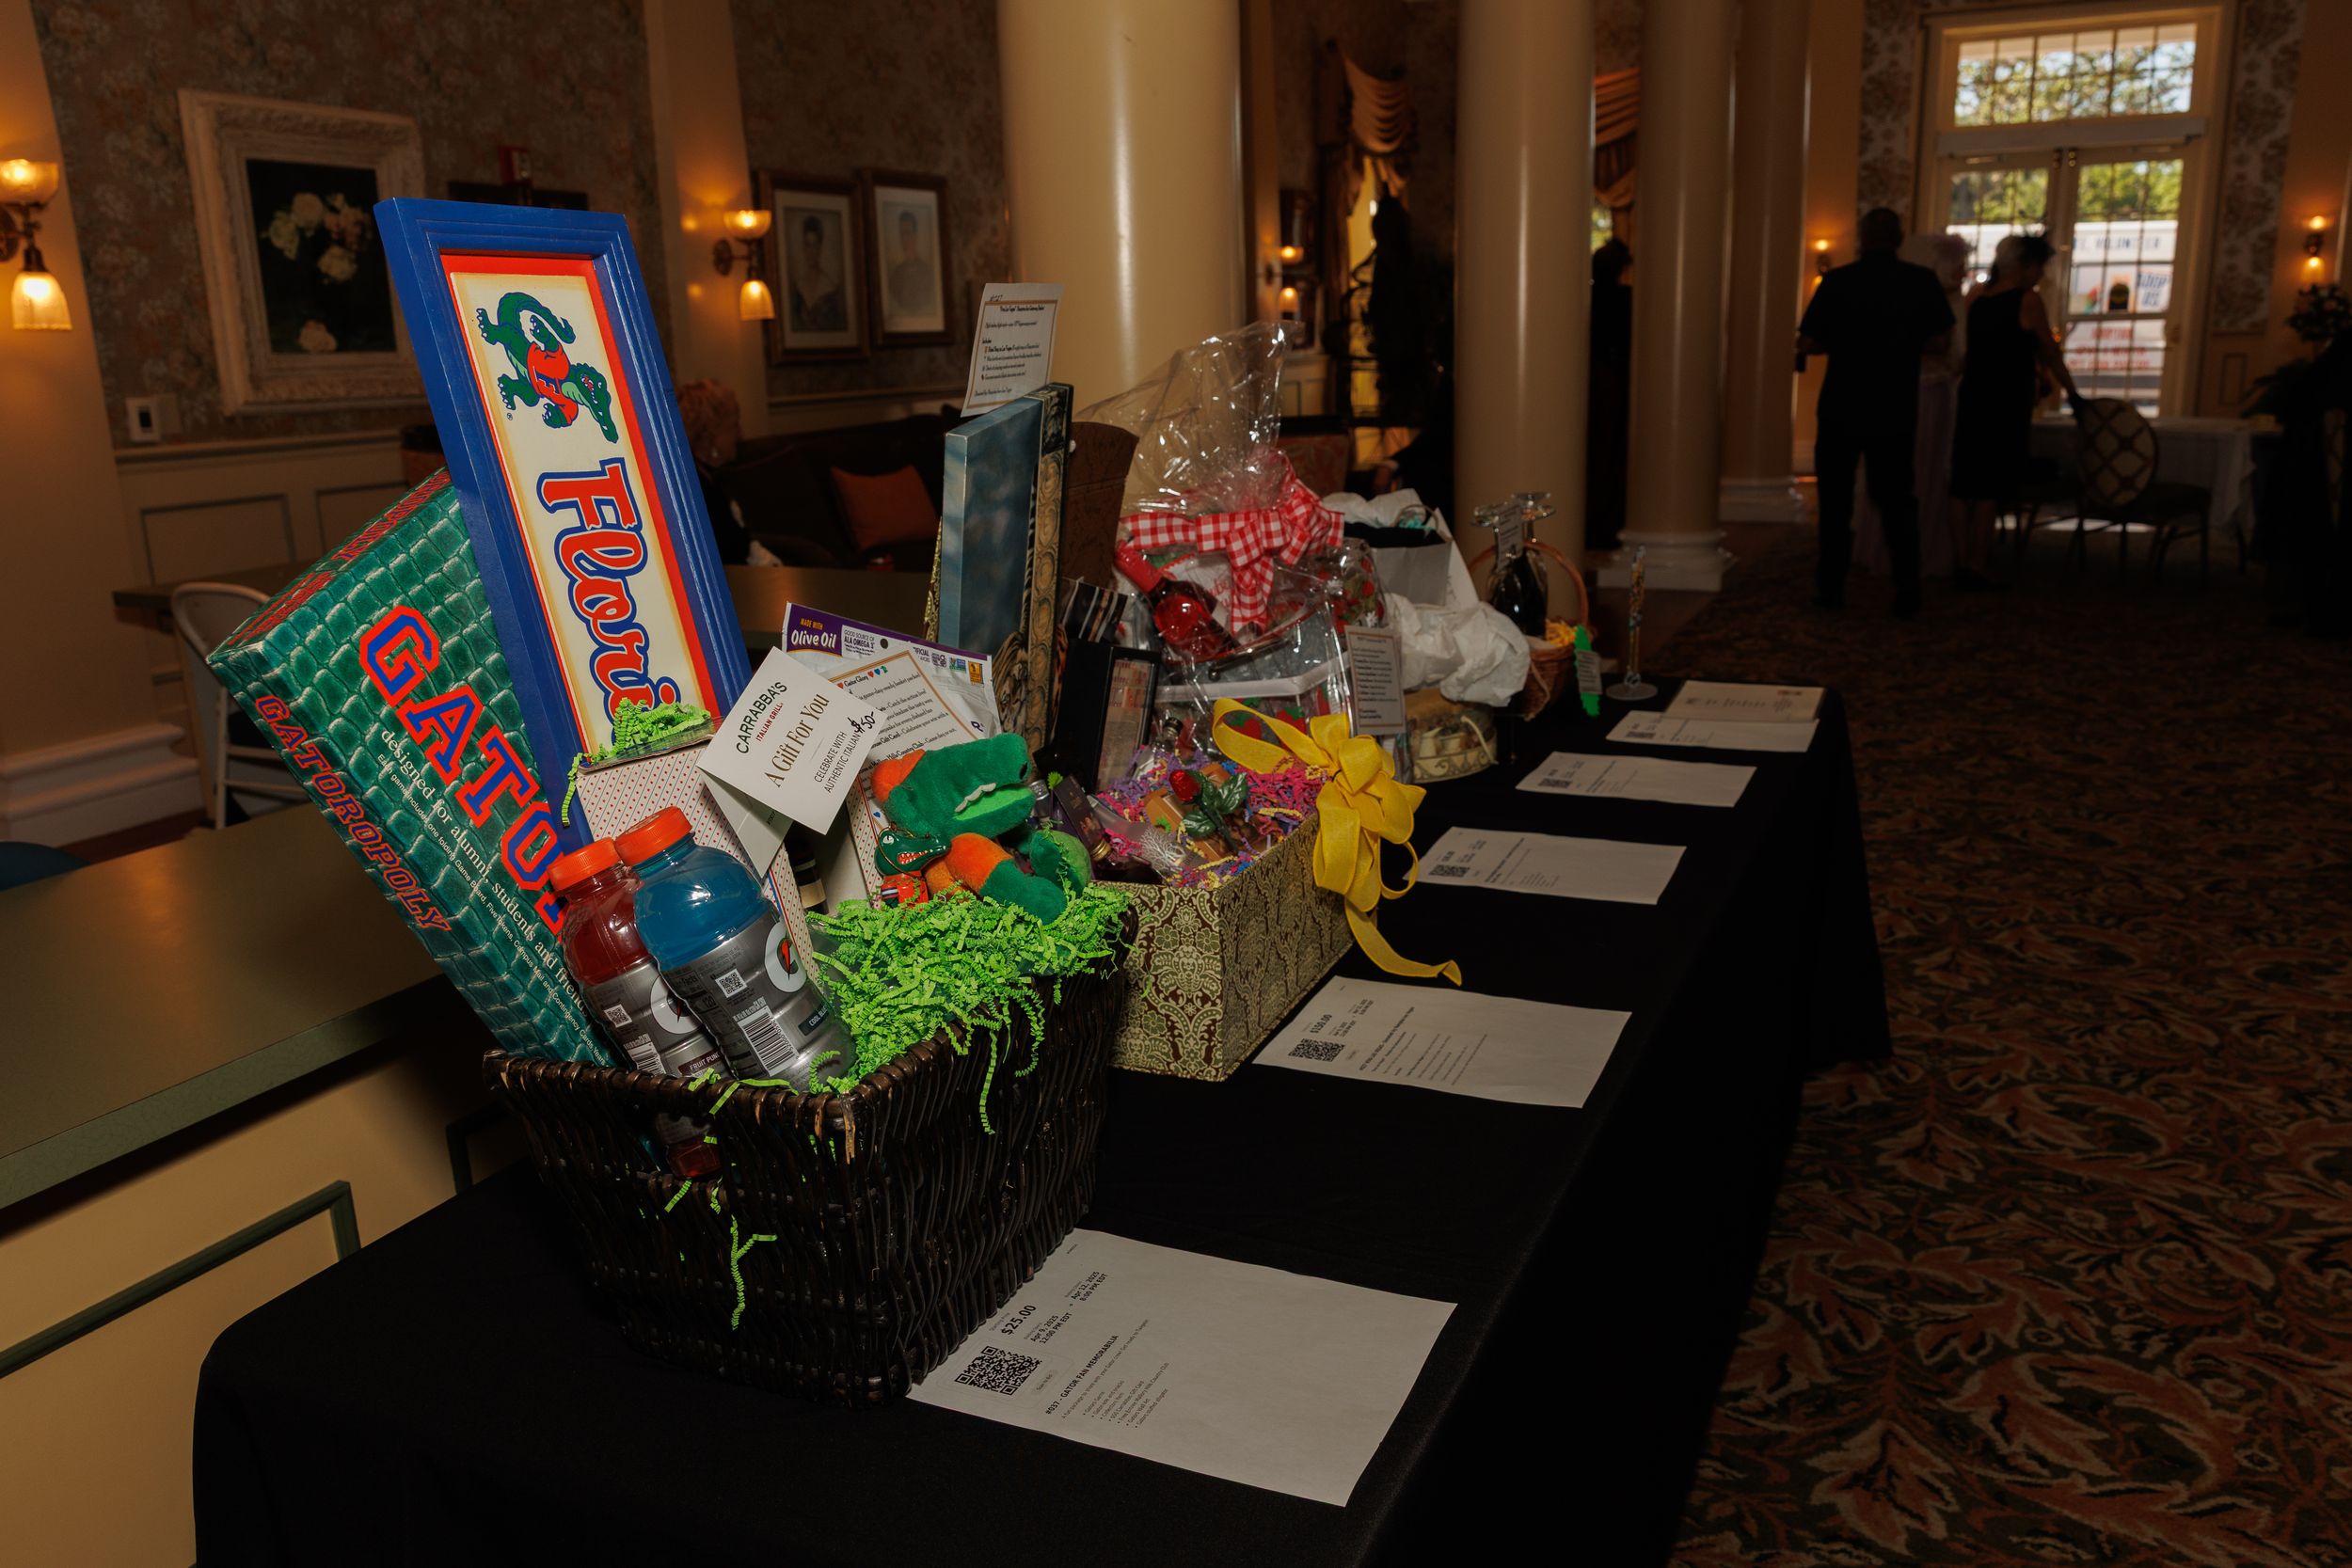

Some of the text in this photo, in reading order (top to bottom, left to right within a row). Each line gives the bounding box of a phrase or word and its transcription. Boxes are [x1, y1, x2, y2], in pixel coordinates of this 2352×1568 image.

[536, 456, 682, 740] Flori
[800, 617, 823, 629] MADE WITH
[790, 629, 836, 648] Olive Oil
[843, 636, 852, 644] ALA
[852, 638, 869, 647] OMEGA
[843, 673, 868, 687] Gator Glory
[893, 676, 907, 686] basket
[736, 681, 787, 754] CARRABBA'S
[802, 694, 830, 724] You
[755, 720, 772, 742] ITALIAN
[787, 718, 814, 747] For
[880, 735, 890, 744] Gift
[888, 731, 901, 740] Card
[901, 721, 922, 735] Celebrate
[772, 740, 800, 772] Gift
[815, 731, 847, 783] CELEBRATE WITH
[824, 731, 862, 793] AUTHENTIC ITALIAN
[896, 744, 914, 757] Country
[913, 740, 924, 749] Club
[768, 770, 785, 787] A
[255, 696, 452, 932] GATOROPOLY
[375, 727, 438, 800] designed
[430, 797, 456, 825] for
[446, 823, 498, 884] alumni,
[488, 880, 540, 942] students
[532, 939, 559, 969] and
[375, 753, 394, 774] Each
[389, 773, 408, 795] game
[404, 792, 431, 823] includes
[426, 822, 439, 837] one
[435, 836, 457, 861] folding
[453, 859, 472, 881] Game
[467, 880, 488, 905] Board,
[511, 939, 536, 968] Campus
[532, 965, 545, 981] Mail
[542, 979, 554, 993] and
[549, 992, 581, 1030] Contingency
[807, 1013, 821, 1026] COOL
[689, 1058, 707, 1070] FRUIT
[1069, 1271, 1100, 1299] Apr 12, 2025
[1078, 1290, 1093, 1301] 8:00
[1095, 1273, 1108, 1282] EDT
[1001, 1305, 1037, 1336] $25.00
[1029, 1332, 1042, 1341] Apr
[1043, 1314, 1058, 1326] 2025
[1038, 1329, 1056, 1343] 12:00
[1058, 1312, 1073, 1322] EDT
[1043, 1401, 1061, 1414] #037
[1058, 1379, 1081, 1397] GATOR
[1075, 1368, 1089, 1379] FAN
[1086, 1335, 1120, 1368] MEMORABILIA
